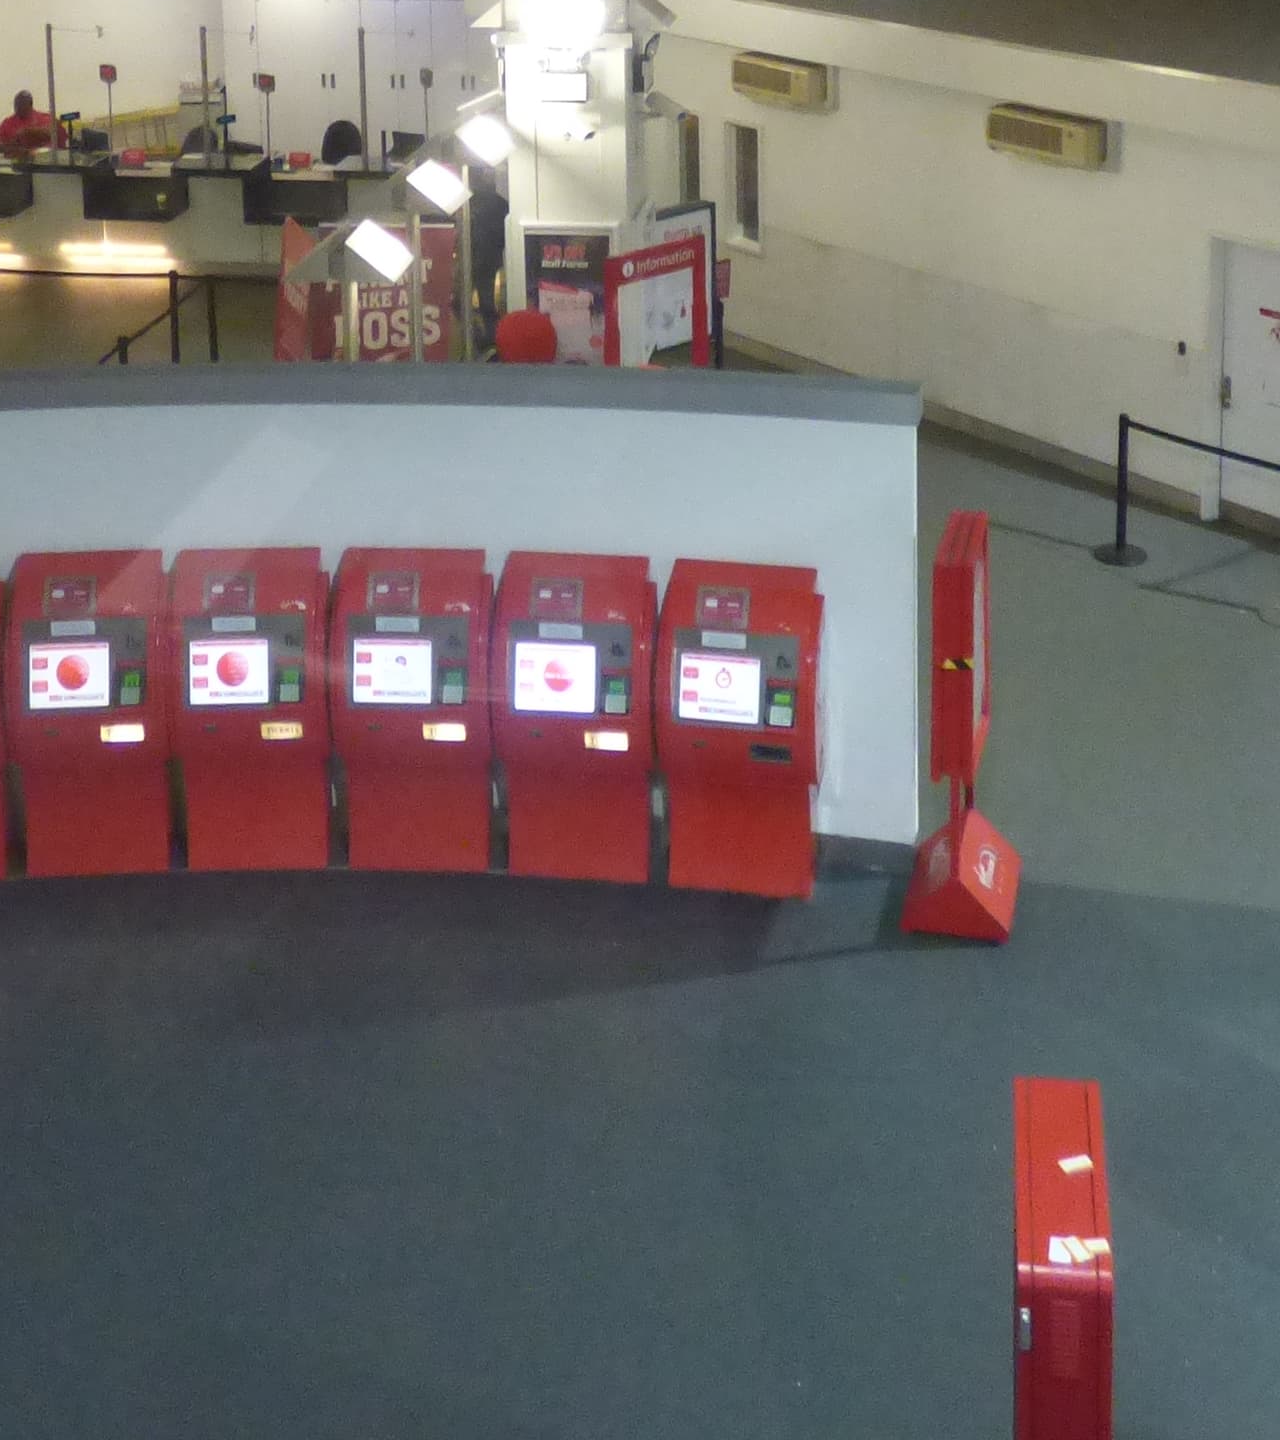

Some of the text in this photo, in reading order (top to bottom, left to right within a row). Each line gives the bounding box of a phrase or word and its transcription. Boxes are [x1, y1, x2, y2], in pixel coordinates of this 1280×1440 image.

[637, 248, 695, 273] Information
[354, 288, 409, 309] IKE A
